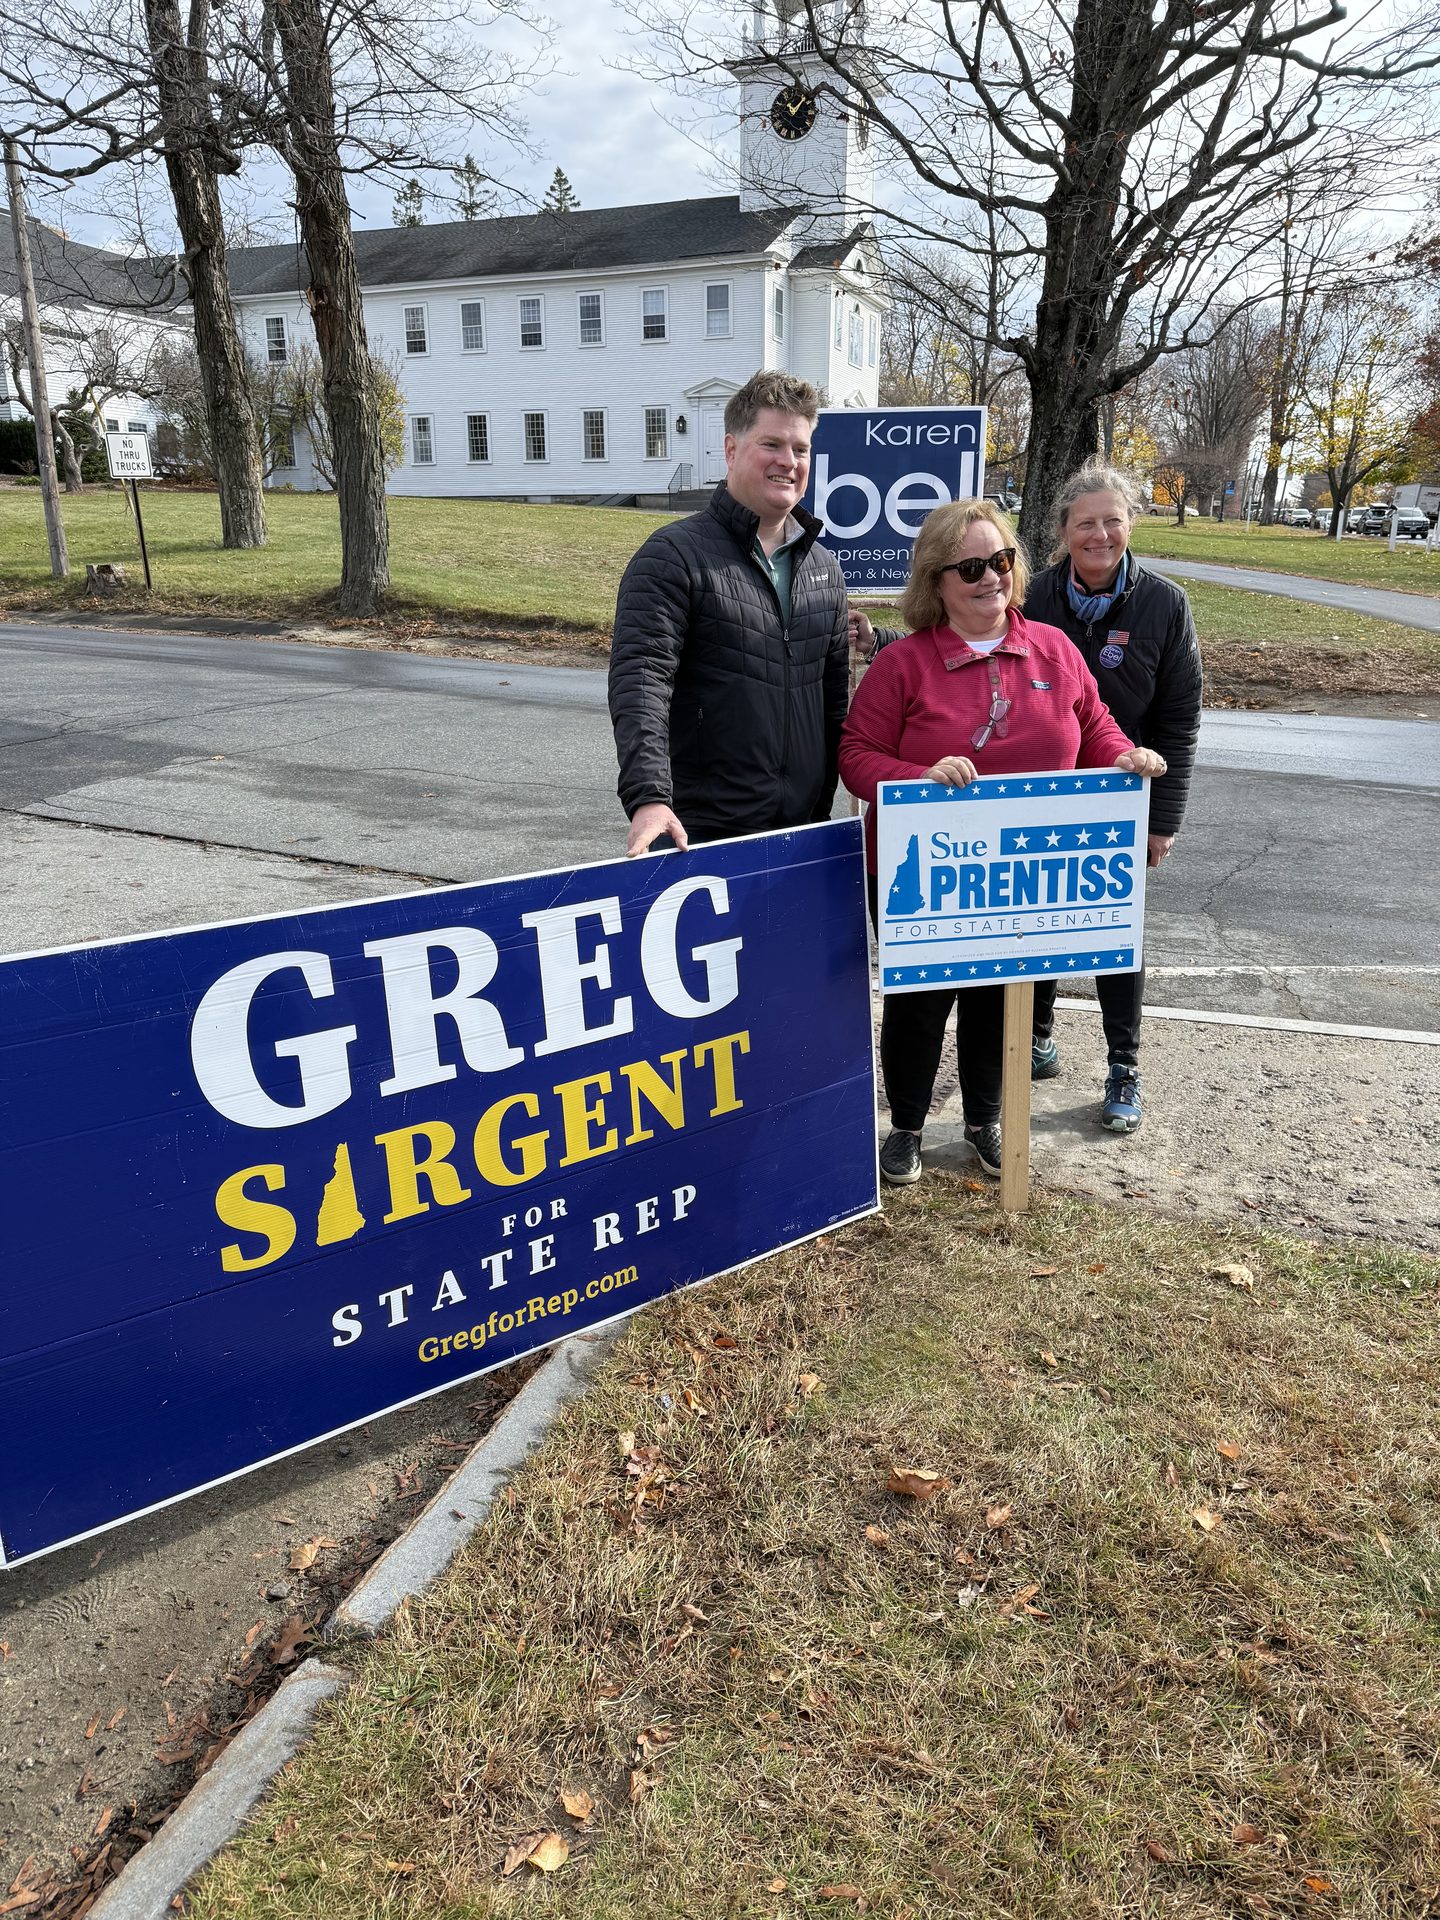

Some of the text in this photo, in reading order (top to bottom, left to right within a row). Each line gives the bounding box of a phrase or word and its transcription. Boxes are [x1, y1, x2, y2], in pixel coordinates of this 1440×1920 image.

[122, 440, 133, 449] NO
[866, 419, 976, 446] Karen
[115, 462, 146, 470] TRUCKS
[118, 451, 140, 459] THRU
[814, 451, 975, 539] bel
[843, 568, 913, 579] on & New
[931, 832, 988, 859] Sue
[930, 853, 1134, 912] PRENTISS
[895, 910, 1121, 938] FOR STATE SENATE
[190, 874, 743, 1129] GREG
[502, 1198, 568, 1236] FOR
[331, 1184, 697, 1347] STATE REP
[418, 1265, 639, 1363] GregforRep.com
